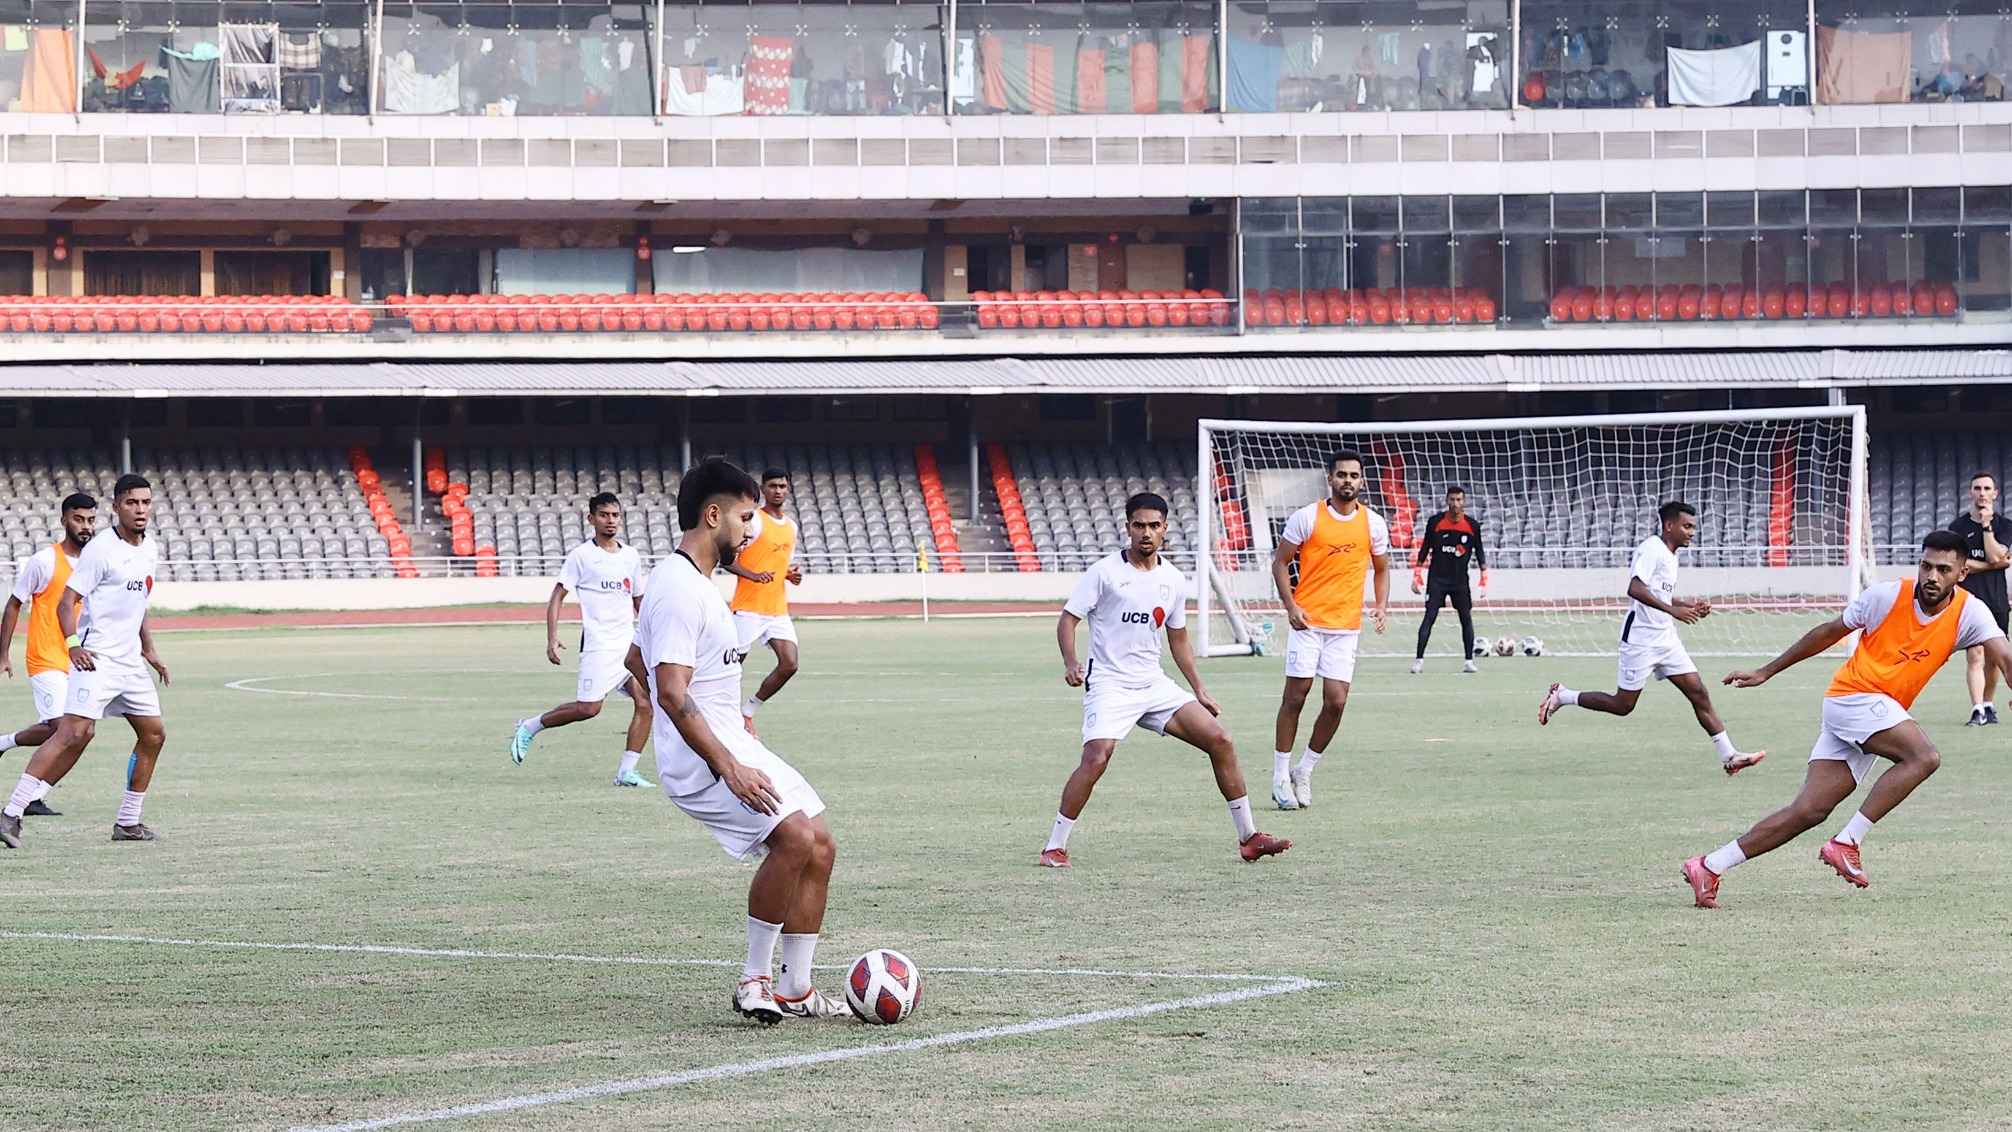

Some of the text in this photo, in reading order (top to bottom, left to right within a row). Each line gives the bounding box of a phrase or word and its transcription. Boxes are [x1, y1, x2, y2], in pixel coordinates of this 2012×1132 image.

[127, 580, 143, 591] UCB
[601, 581, 622, 590] UCB
[1121, 612, 1149, 624] UCB
